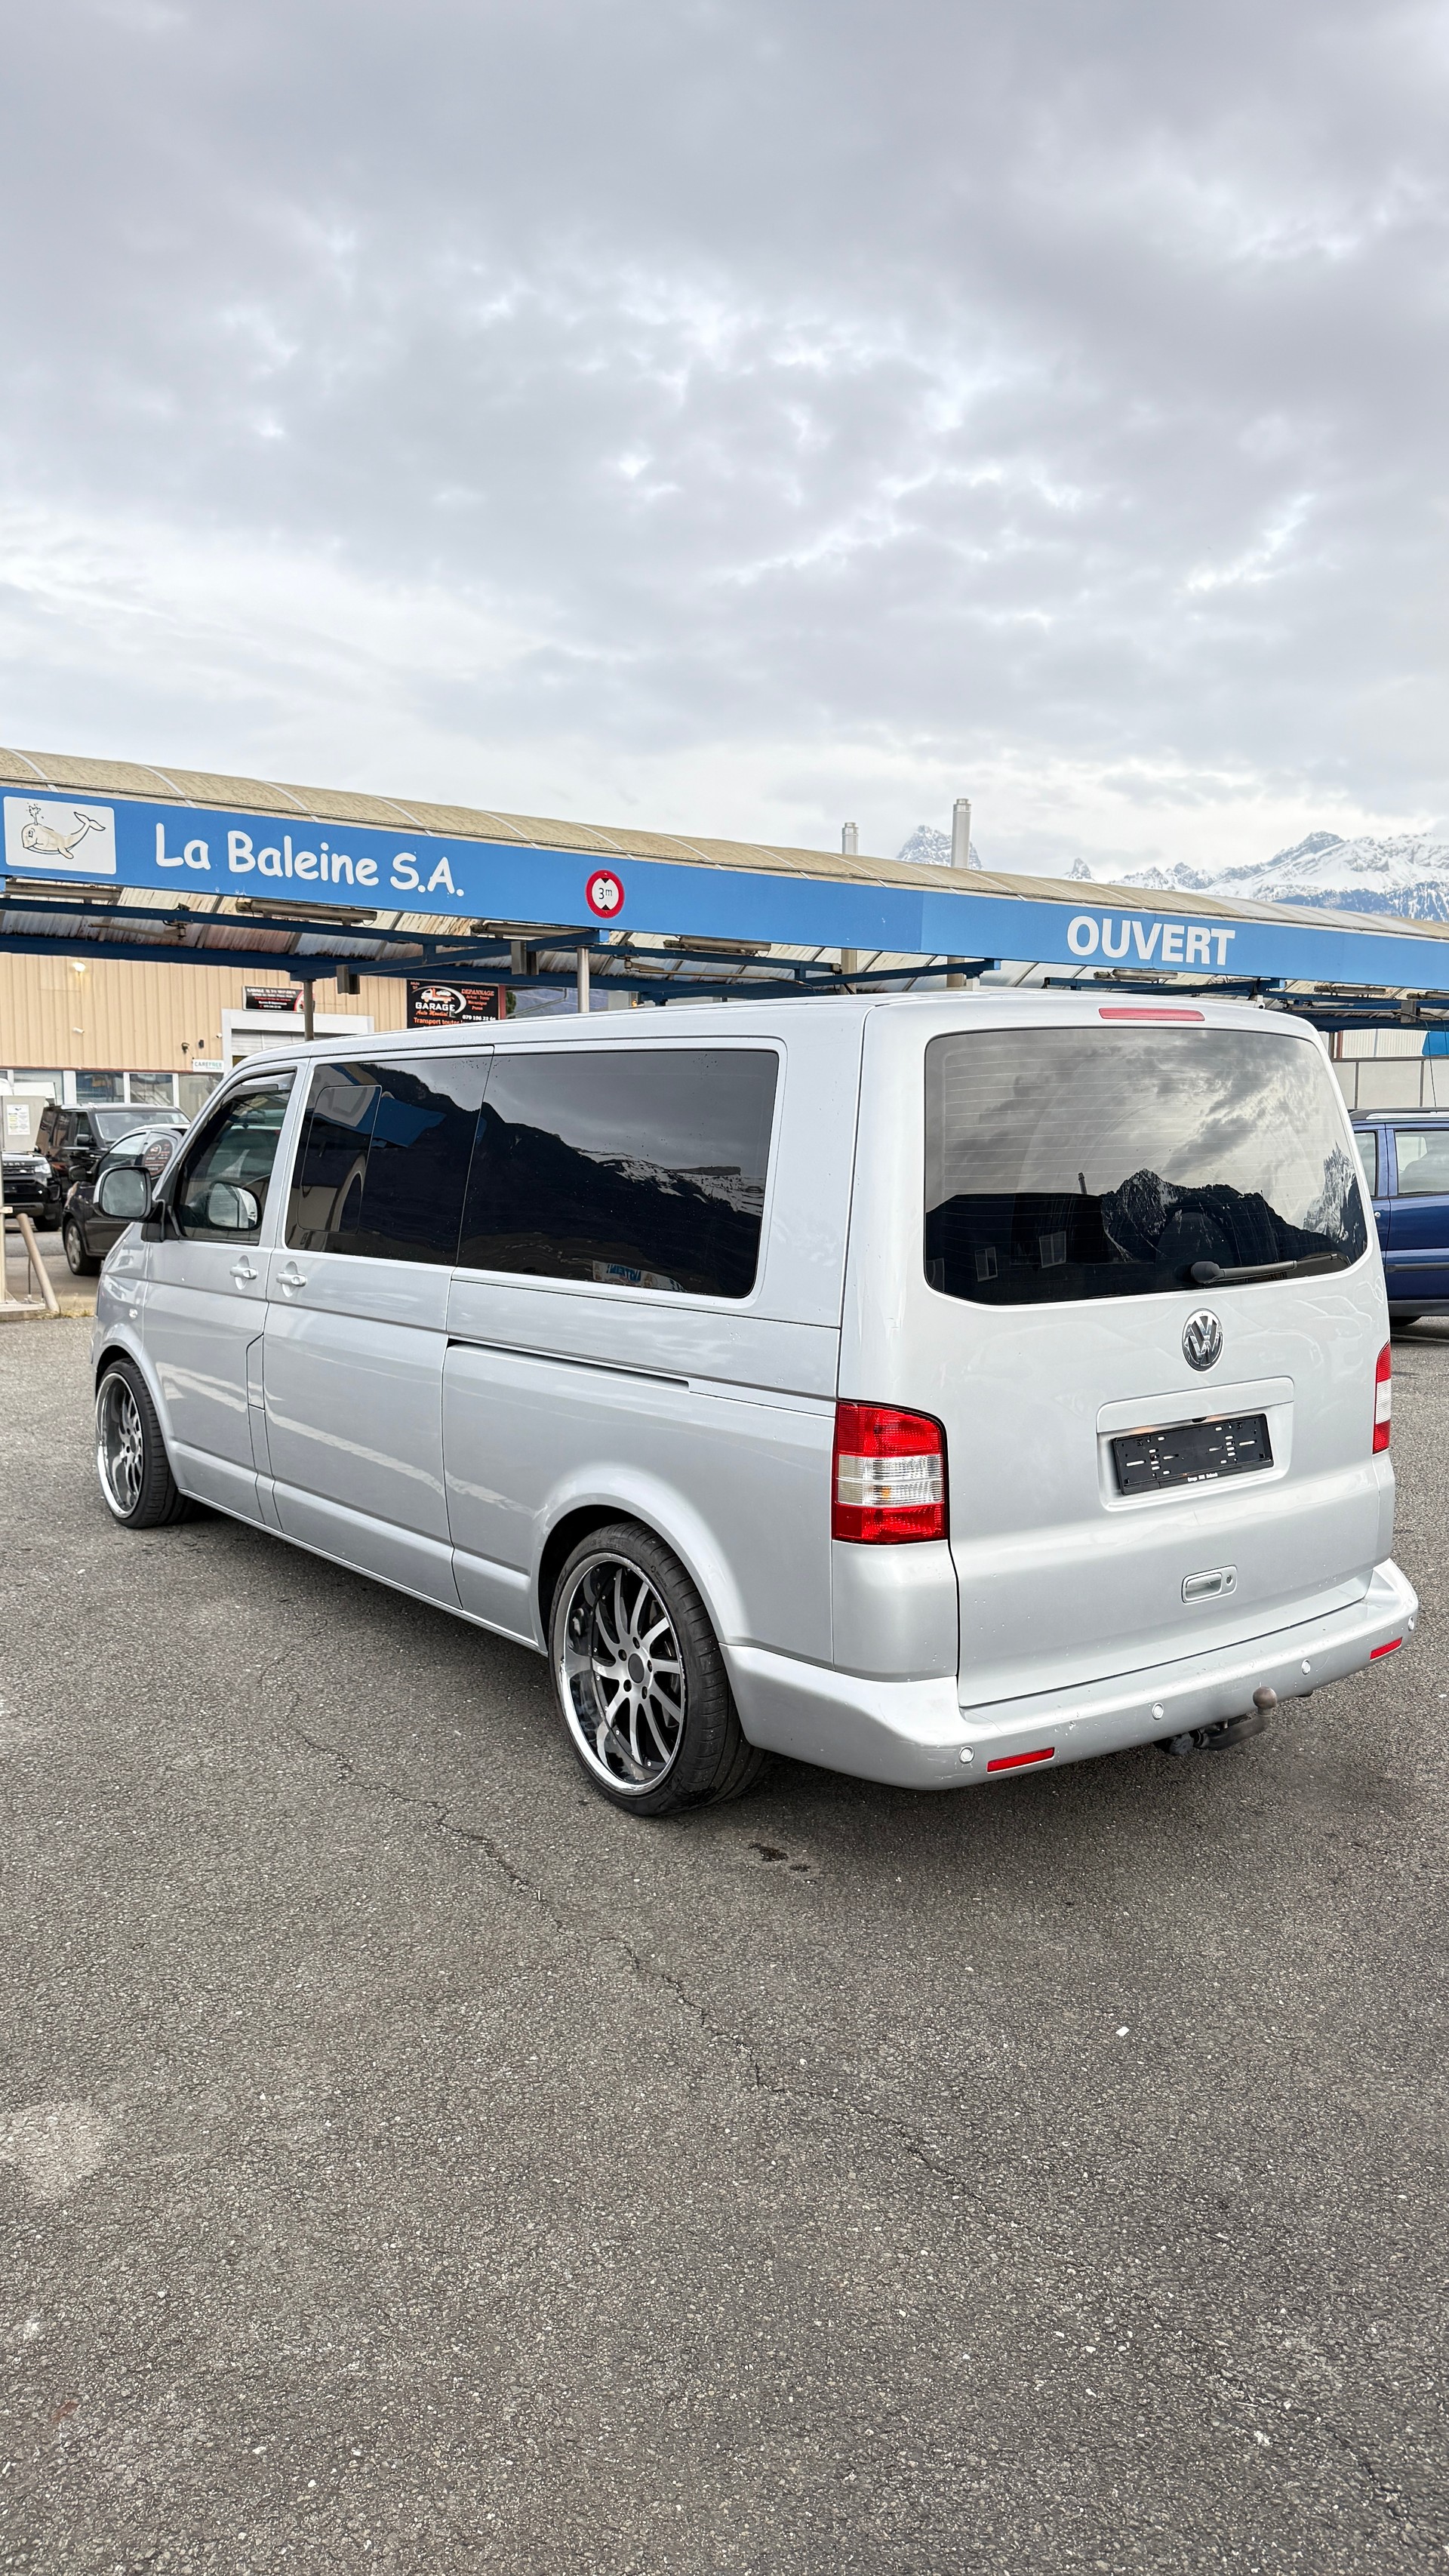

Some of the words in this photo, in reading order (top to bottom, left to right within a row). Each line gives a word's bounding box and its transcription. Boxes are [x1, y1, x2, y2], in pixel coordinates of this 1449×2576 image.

[155, 823, 211, 870] La
[228, 830, 379, 886] Baleine
[389, 852, 465, 897] S.A.
[1066, 916, 1236, 965] OUVERT
[415, 1002, 456, 1011] GARAGE
